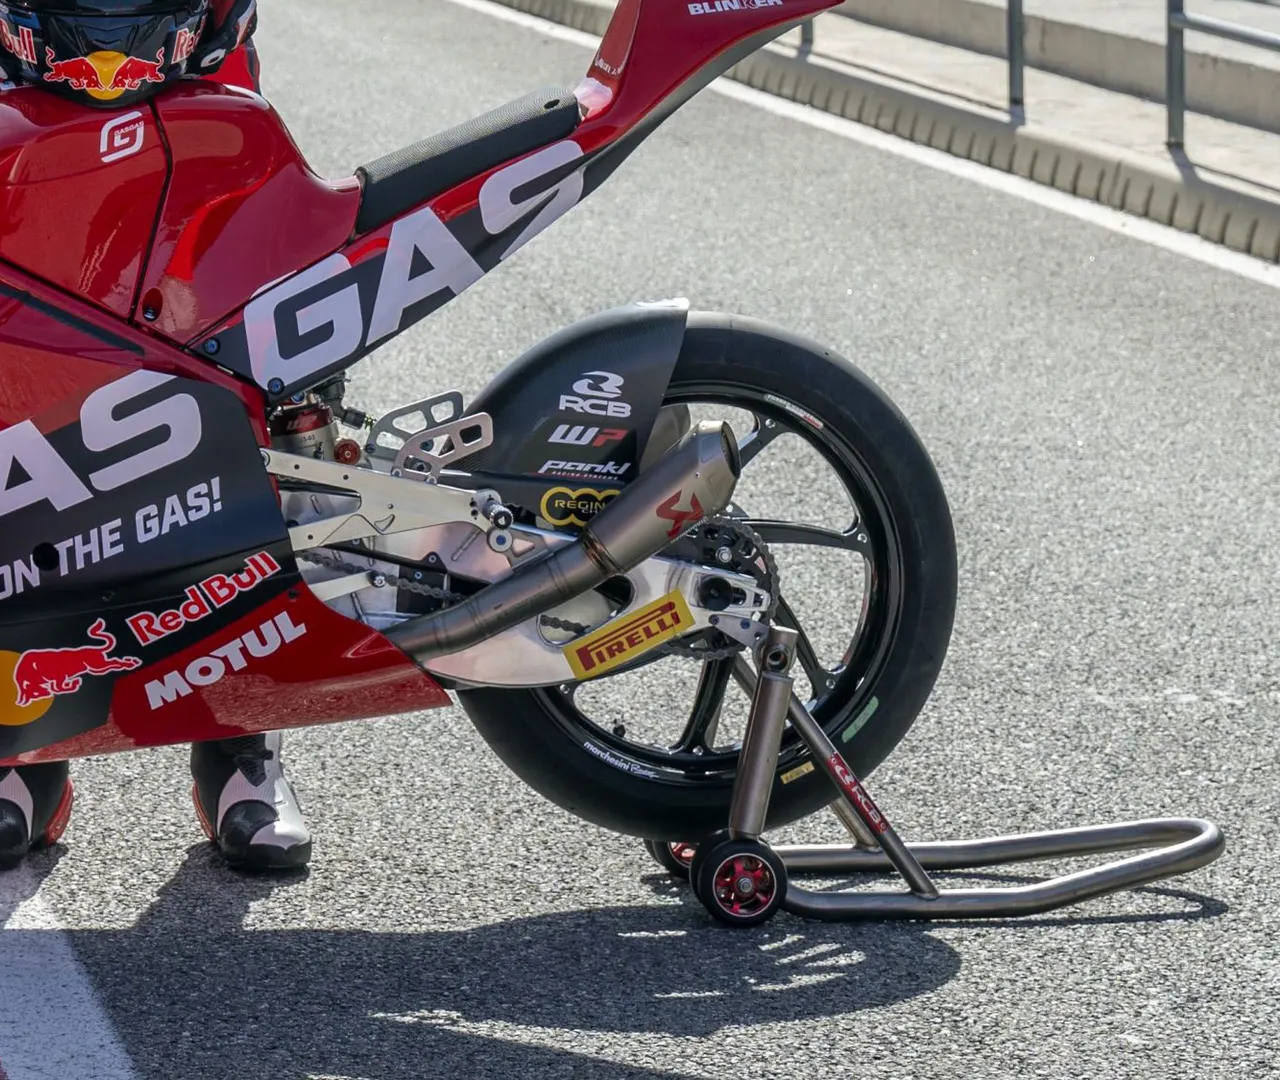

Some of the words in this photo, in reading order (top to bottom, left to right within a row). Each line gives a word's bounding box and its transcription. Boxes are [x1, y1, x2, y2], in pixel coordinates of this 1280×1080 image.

[244, 139, 586, 397] GAS
[558, 393, 632, 418] RCB
[547, 424, 627, 447] WP
[537, 459, 631, 475] pankl
[553, 499, 606, 511] REGIN
[54, 518, 124, 577] THE
[135, 476, 223, 544] GAS!
[125, 593, 204, 647] Red
[201, 550, 282, 608] Bull
[574, 599, 683, 674] PIRELLI
[143, 610, 307, 710] MOTUL
[584, 741, 631, 771] marchesini
[851, 786, 881, 824] RCB
